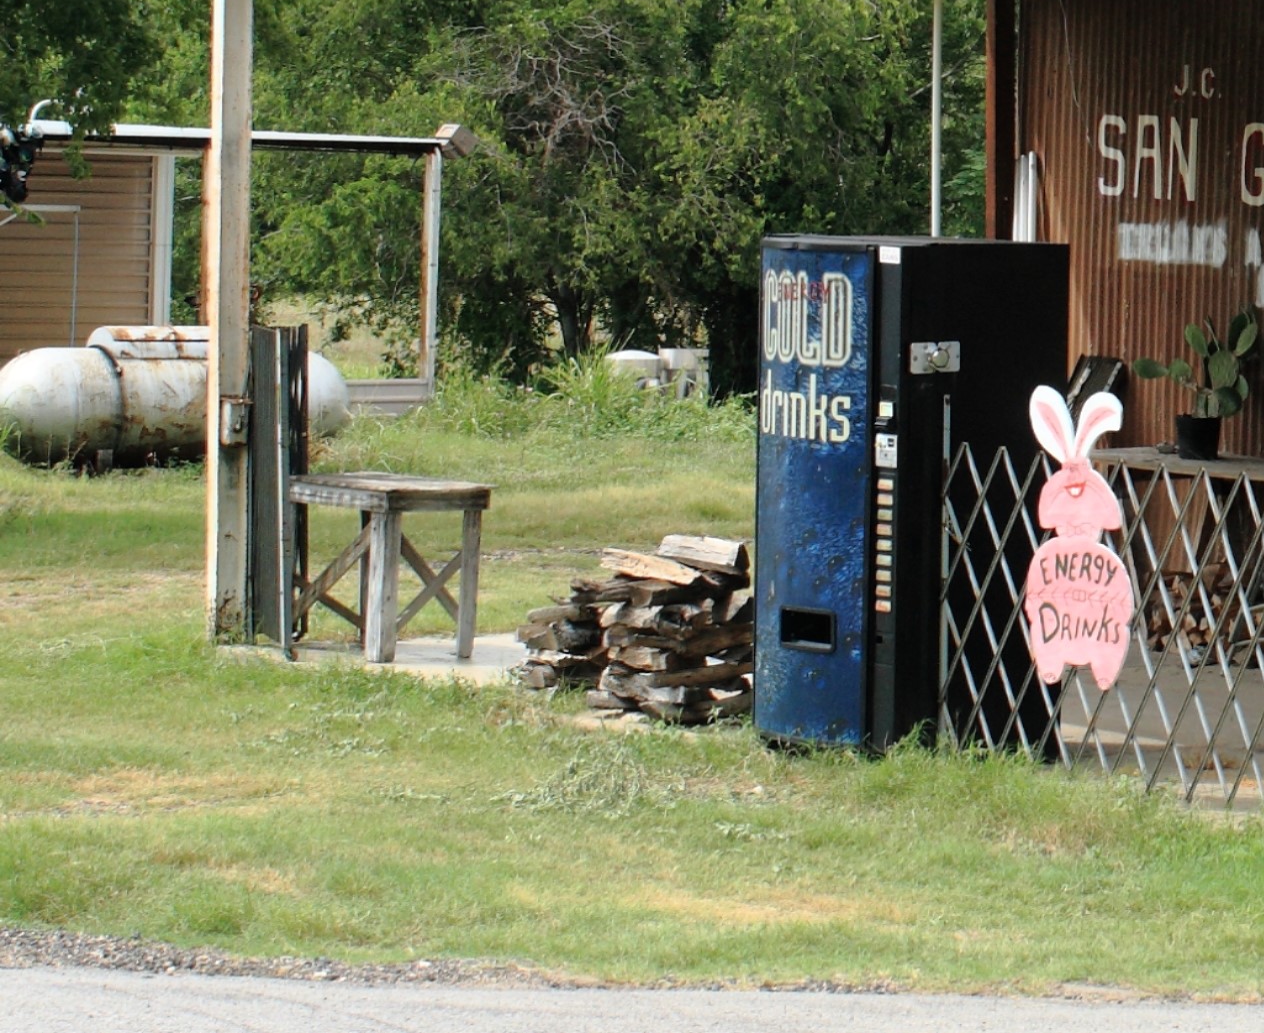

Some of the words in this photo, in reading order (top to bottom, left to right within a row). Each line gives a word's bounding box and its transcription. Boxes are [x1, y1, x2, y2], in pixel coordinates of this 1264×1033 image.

[1098, 114, 1199, 202] SAN
[763, 269, 853, 367] COLD
[761, 369, 851, 443] drinks
[1040, 552, 1118, 586] ENERGY
